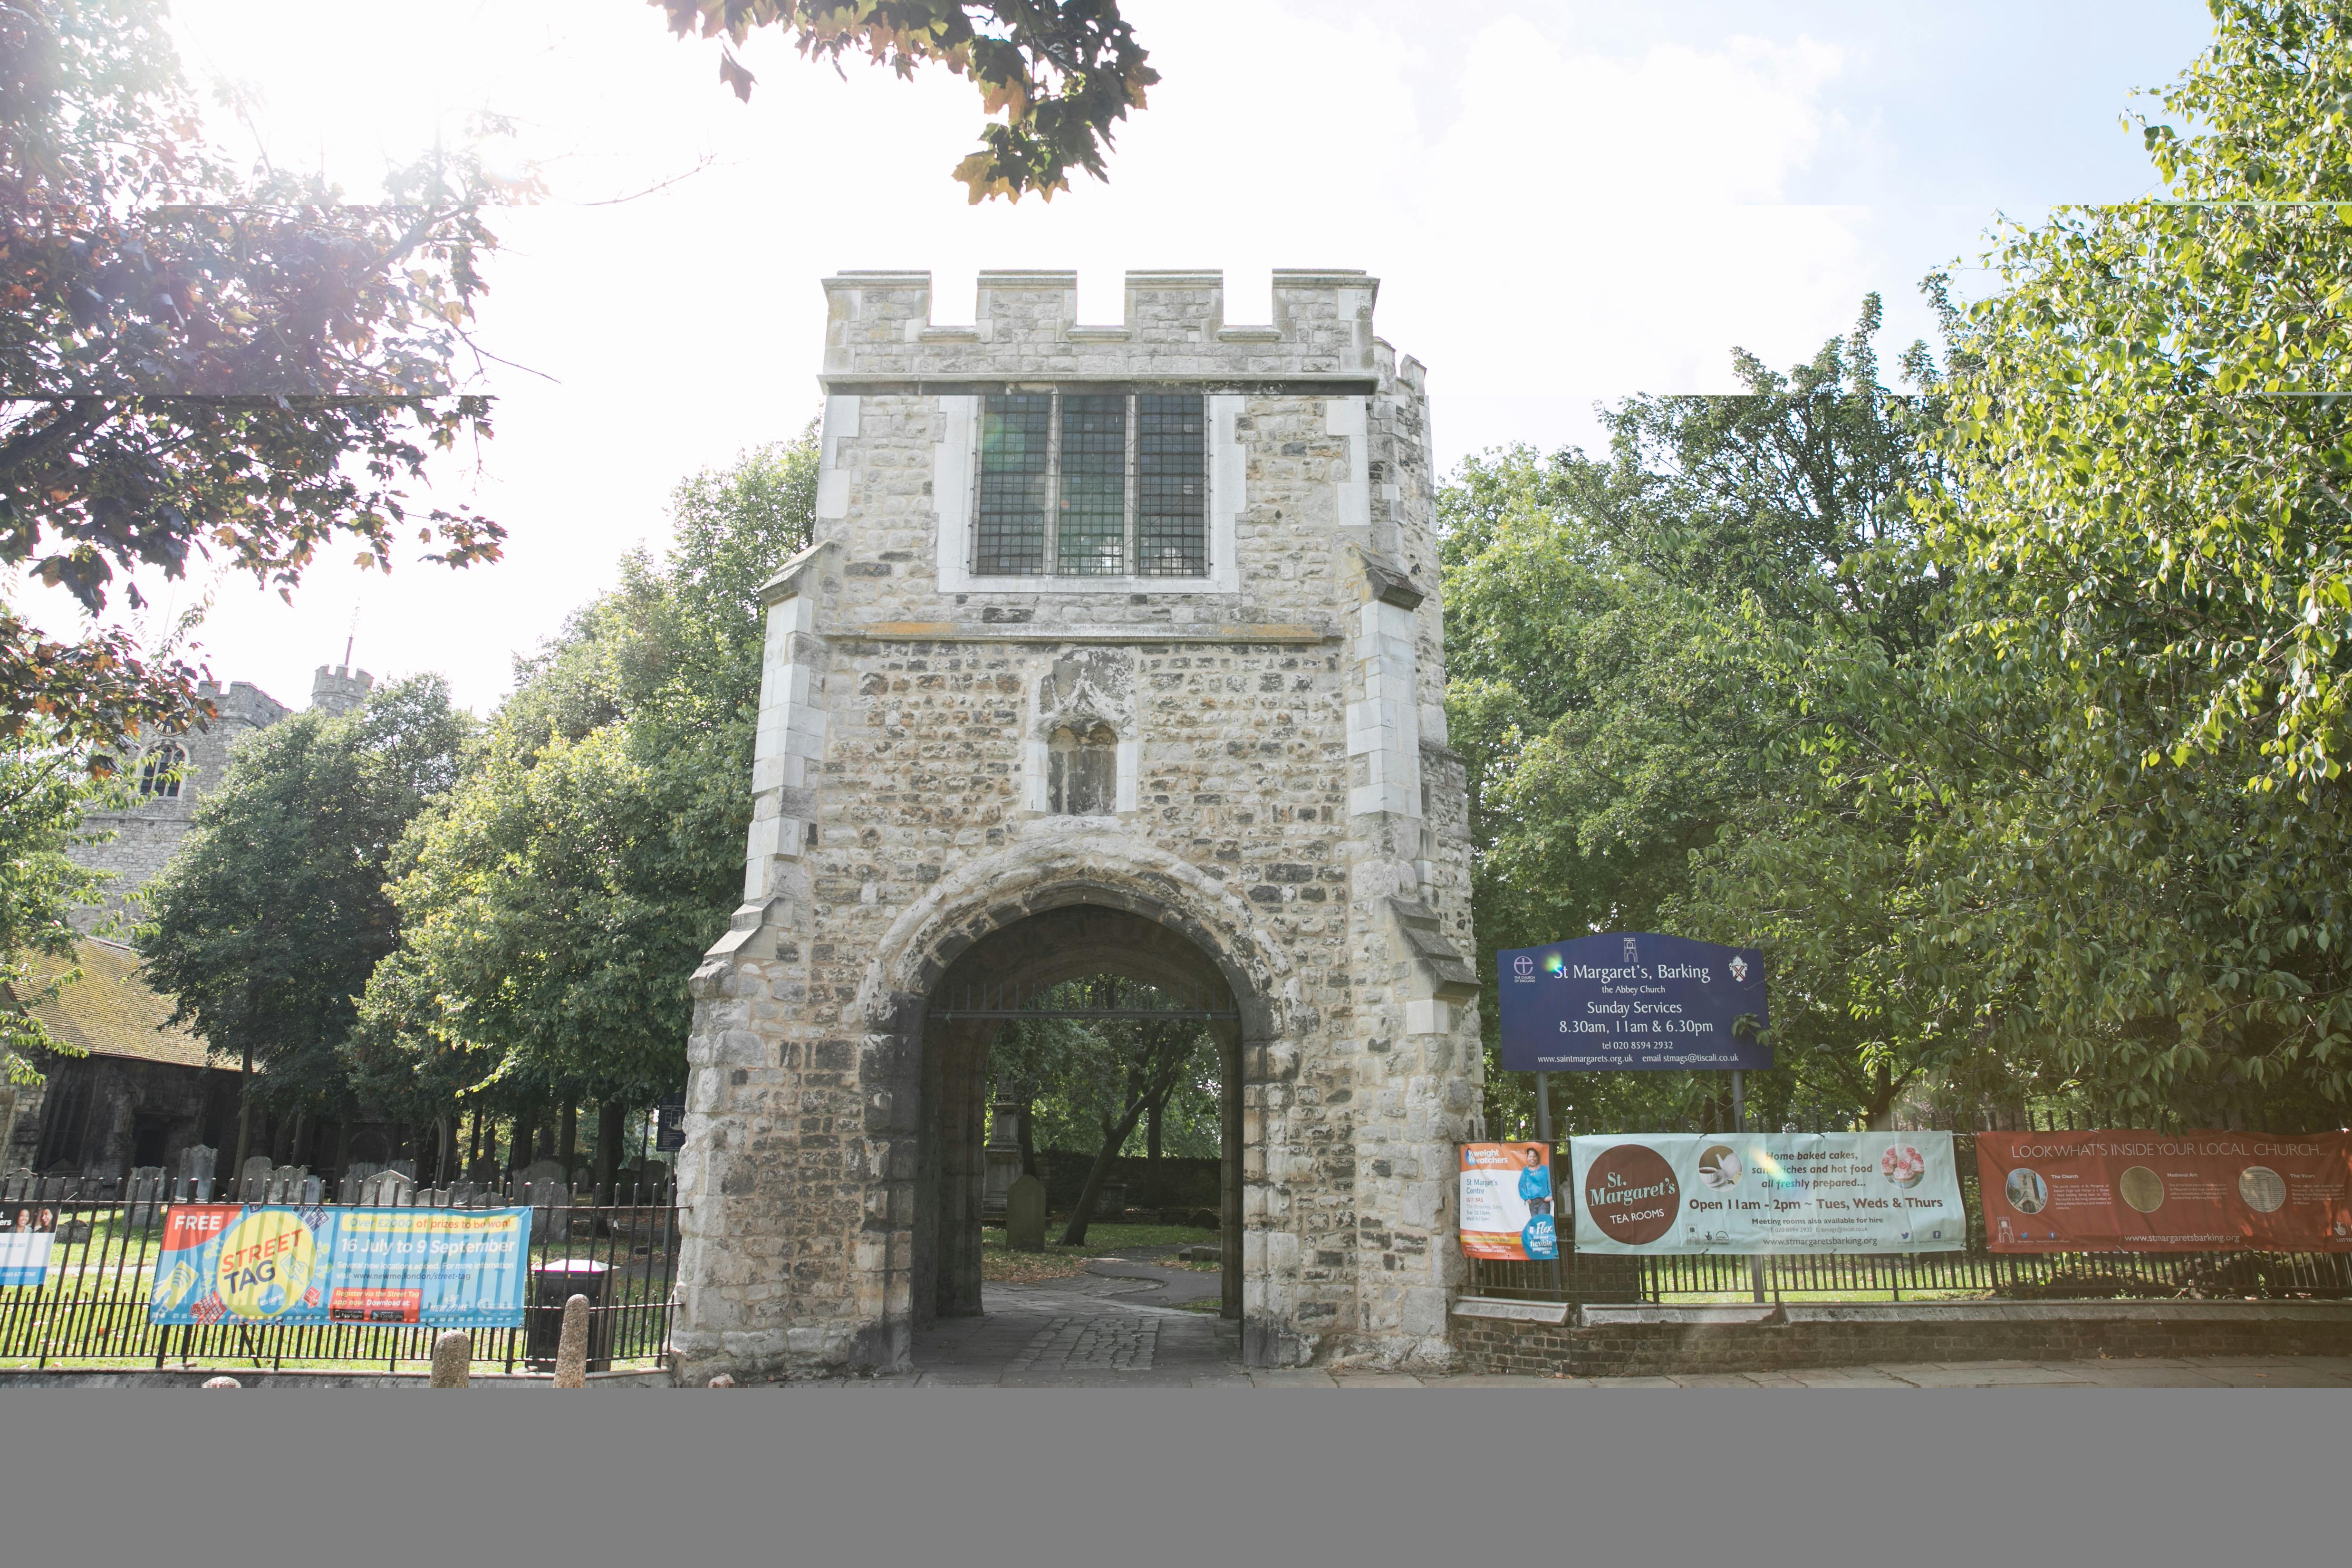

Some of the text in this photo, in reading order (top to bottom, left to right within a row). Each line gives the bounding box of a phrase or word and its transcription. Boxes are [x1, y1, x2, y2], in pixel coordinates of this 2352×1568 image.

[1554, 963, 1711, 983] St Margaret's, Barking
[1616, 986, 1638, 995] Abbey
[1587, 1001, 1682, 1018] Sunday Services
[1559, 1020, 1713, 1036] 8.30am, 11am & 6.30pm
[1602, 1041, 1611, 1049] tel
[1613, 1041, 1629, 1049] 020
[1631, 1041, 1651, 1049] 8594
[1538, 1053, 1739, 1065] www.saintmargarets.org.uk email stmags@tiscali.co.uk
[1766, 1151, 1858, 1160] Home baked cakes,
[2012, 1143, 2327, 1158] LOOK WHAT'S INSIDE YOUR LOCAL CHURCH...
[1752, 1164, 1872, 1174] saniches and hot food
[1608, 1172, 1627, 1188] St.
[1776, 1179, 1809, 1189] freshly
[1813, 1179, 1866, 1189] prepared...
[1590, 1177, 1676, 1206] Margaret's
[1689, 1199, 1722, 1212] Open
[1728, 1199, 1760, 1209] 11am
[1773, 1199, 1801, 1212] 2pm
[1816, 1198, 1849, 1210] Tues,
[1852, 1198, 1889, 1208] Weds
[1892, 1198, 1901, 1207] &
[1905, 1197, 1943, 1207] Thurs
[174, 1215, 222, 1230] FREE
[350, 1218, 511, 1229] Over £2000 of prizes to be won!
[1610, 1209, 1664, 1224] TEA ROOMS
[1536, 1221, 1553, 1235] Flex
[1763, 1237, 1878, 1247] www.stmargaretsbarking.org
[2124, 1233, 2240, 1244] www.stmargaretsbarking.org
[222, 1229, 303, 1272] STREET
[342, 1238, 516, 1256] 16 July to 9 September
[224, 1260, 276, 1294] TAG
[354, 1272, 471, 1280] www.newme.london/street-tag
